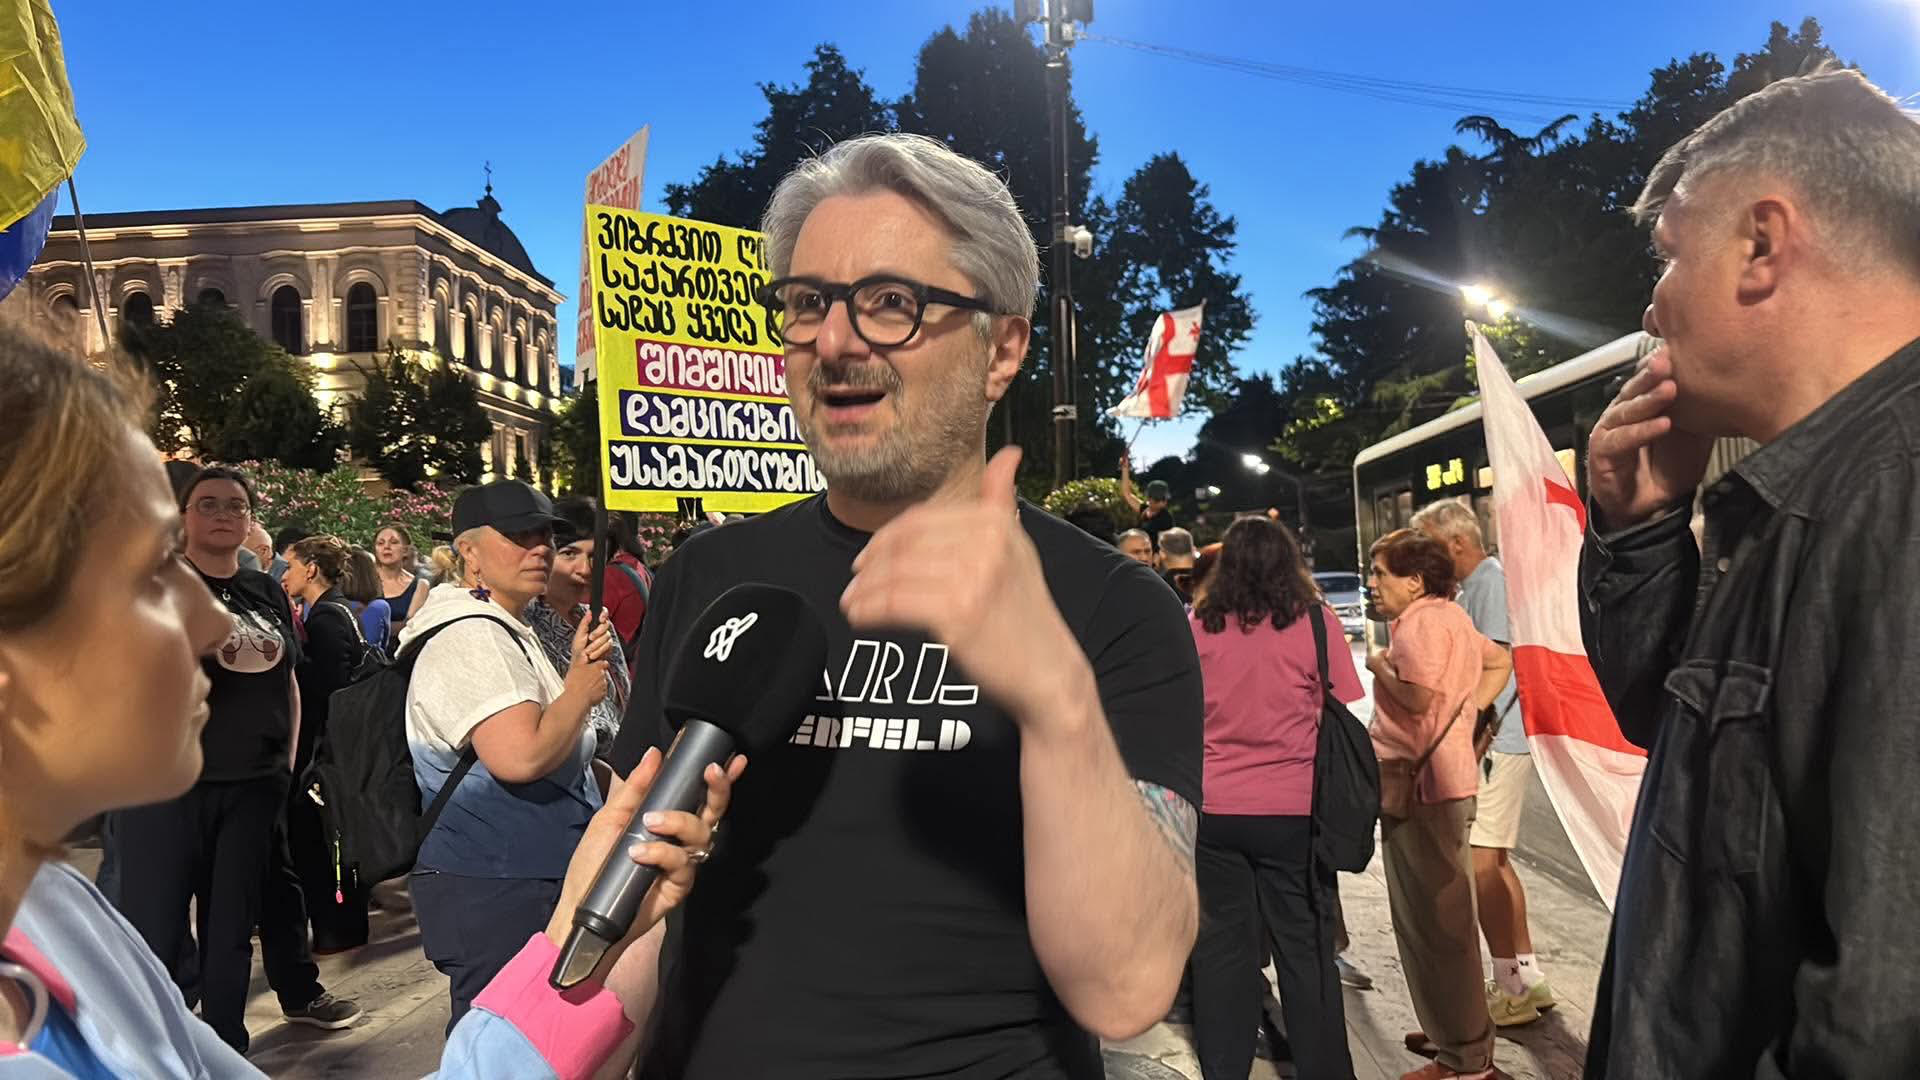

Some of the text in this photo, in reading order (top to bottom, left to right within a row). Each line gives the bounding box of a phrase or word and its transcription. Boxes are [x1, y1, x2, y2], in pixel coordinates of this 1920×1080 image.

[598, 213, 769, 271] ვიბრძვით ღი
[601, 253, 767, 308] საქართველ
[598, 291, 675, 335] სადაც
[687, 303, 758, 346] ყველა
[640, 343, 788, 395] შიმშილის
[626, 393, 804, 441] დამცირები
[610, 445, 828, 492] უსამართლობის
[788, 715, 972, 750] ERFELD
